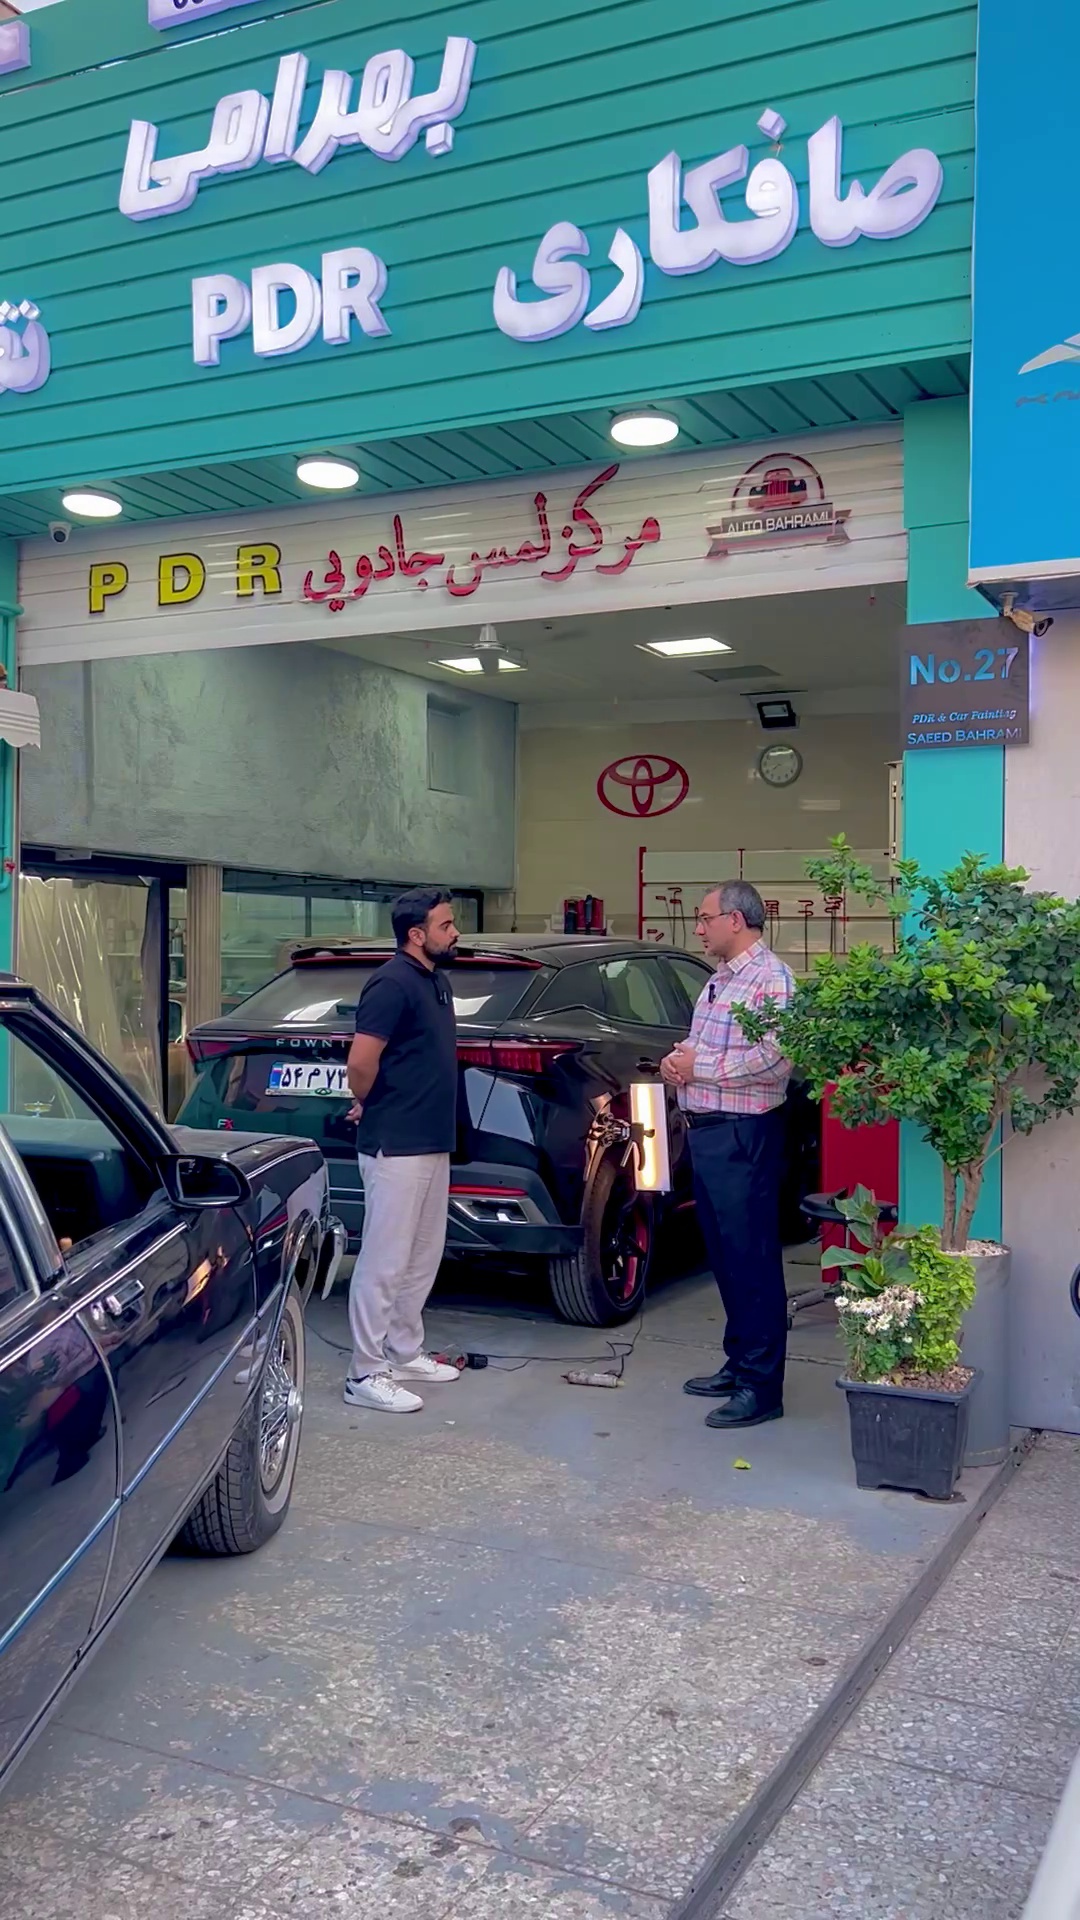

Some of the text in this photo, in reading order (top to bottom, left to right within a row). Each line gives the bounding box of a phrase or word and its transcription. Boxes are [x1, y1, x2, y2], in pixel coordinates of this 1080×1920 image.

[119, 36, 477, 221] بهرامی
[493, 108, 943, 342] صافکاری
[192, 247, 391, 366] PDR
[541, 463, 660, 583] مرکز
[728, 511, 829, 533] AUTO BAHRAMI
[447, 492, 550, 597] لمس
[910, 647, 1018, 685] No.27
[912, 709, 1017, 724] PDR & Car Painting
[907, 727, 1022, 745] SAEED BAHRAMI
[275, 1038, 346, 1049] FOWNI
[217, 1118, 234, 1130] FX
